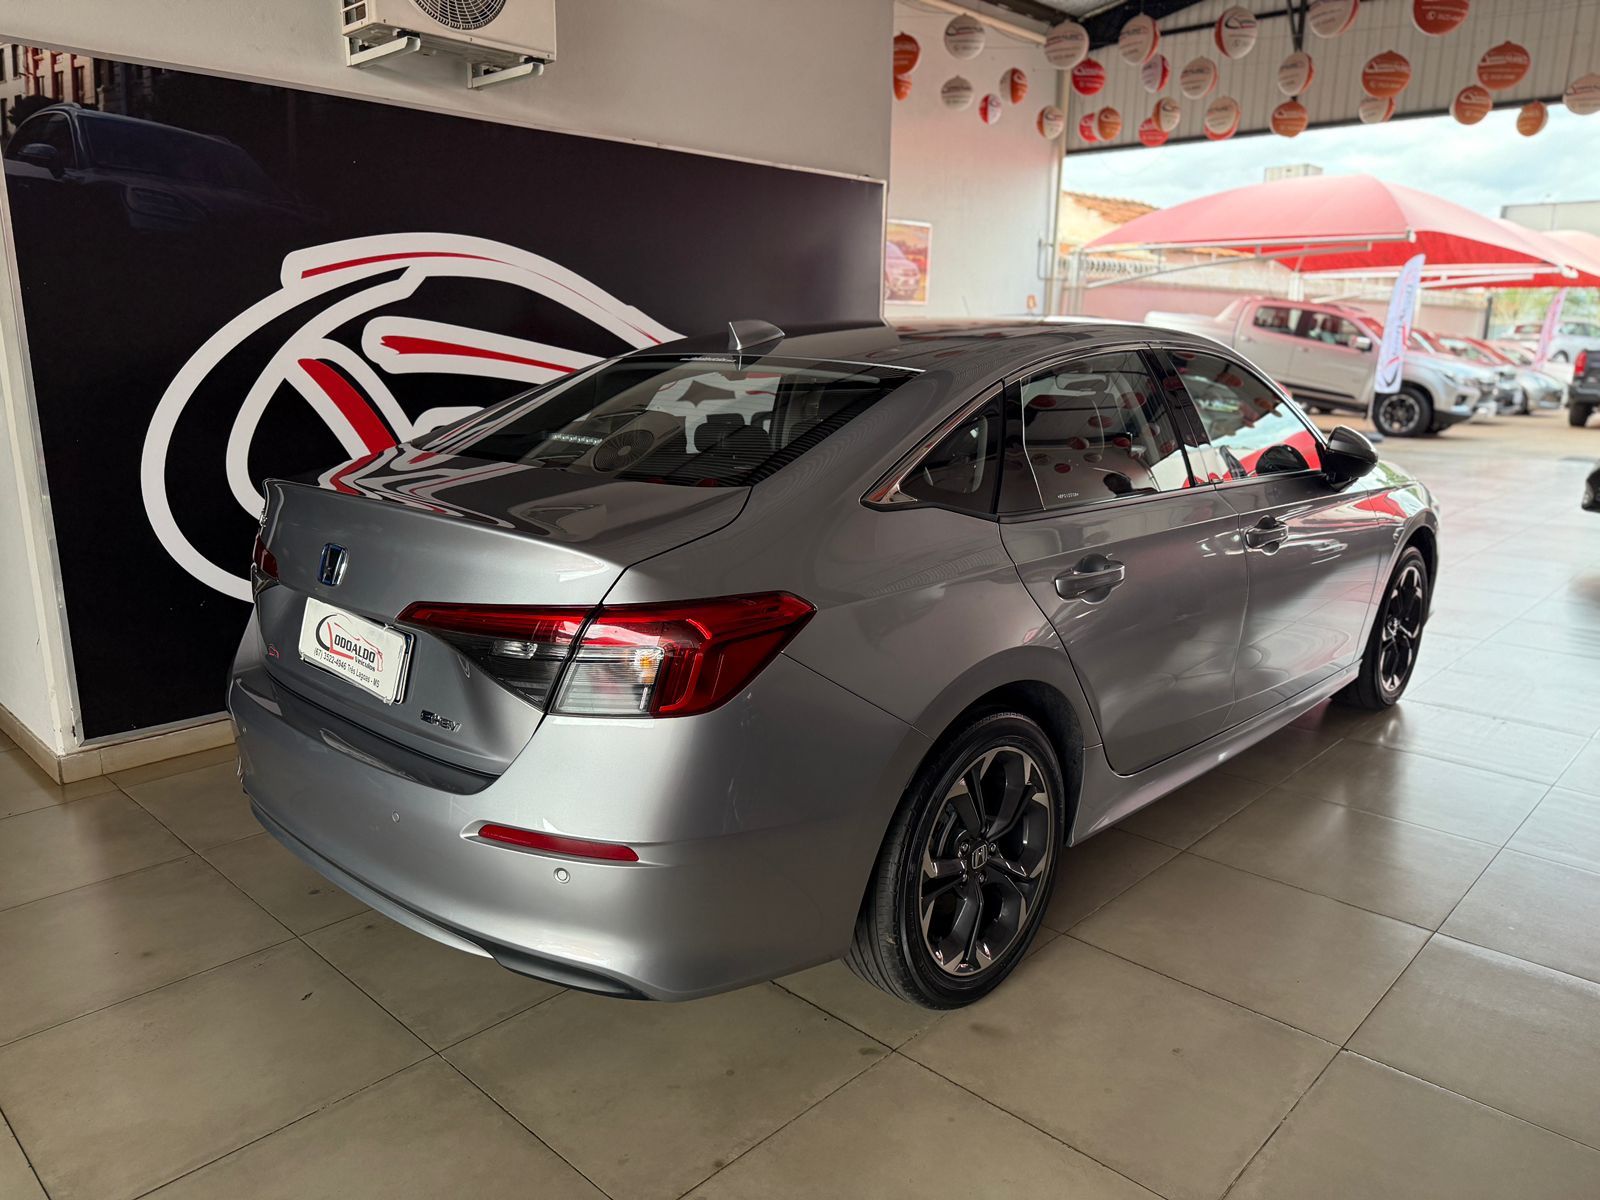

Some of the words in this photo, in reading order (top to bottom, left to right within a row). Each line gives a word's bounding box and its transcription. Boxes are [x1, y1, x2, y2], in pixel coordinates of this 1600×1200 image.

[314, 647, 323, 659] (67)
[356, 668, 371, 683] Lagoas
[373, 677, 381, 688] MS
